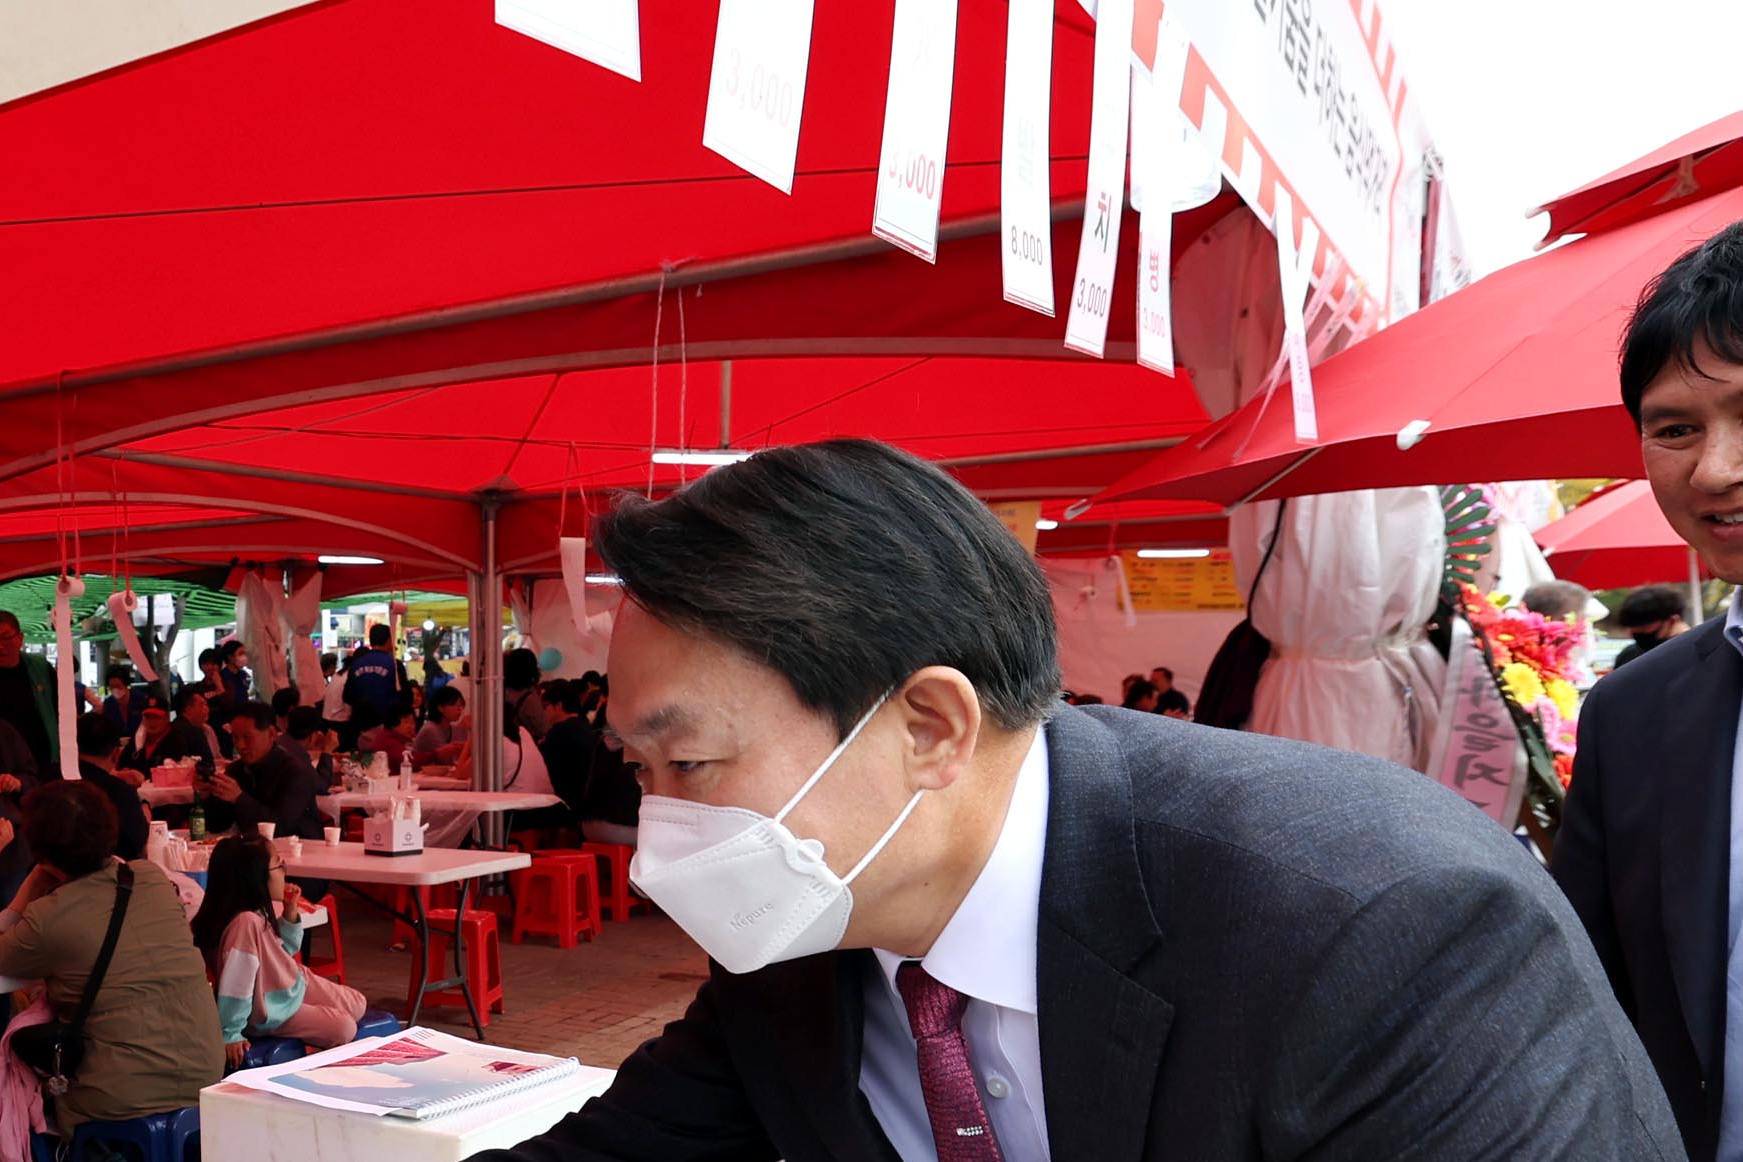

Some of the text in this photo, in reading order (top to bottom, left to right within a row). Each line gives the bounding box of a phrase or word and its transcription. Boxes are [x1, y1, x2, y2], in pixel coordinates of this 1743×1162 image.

[725, 47, 793, 129] 3,000
[887, 143, 936, 200] 3,000
[1011, 225, 1043, 267] 8,000
[1076, 277, 1108, 318] 3,000
[1143, 306, 1166, 338] 3,000
